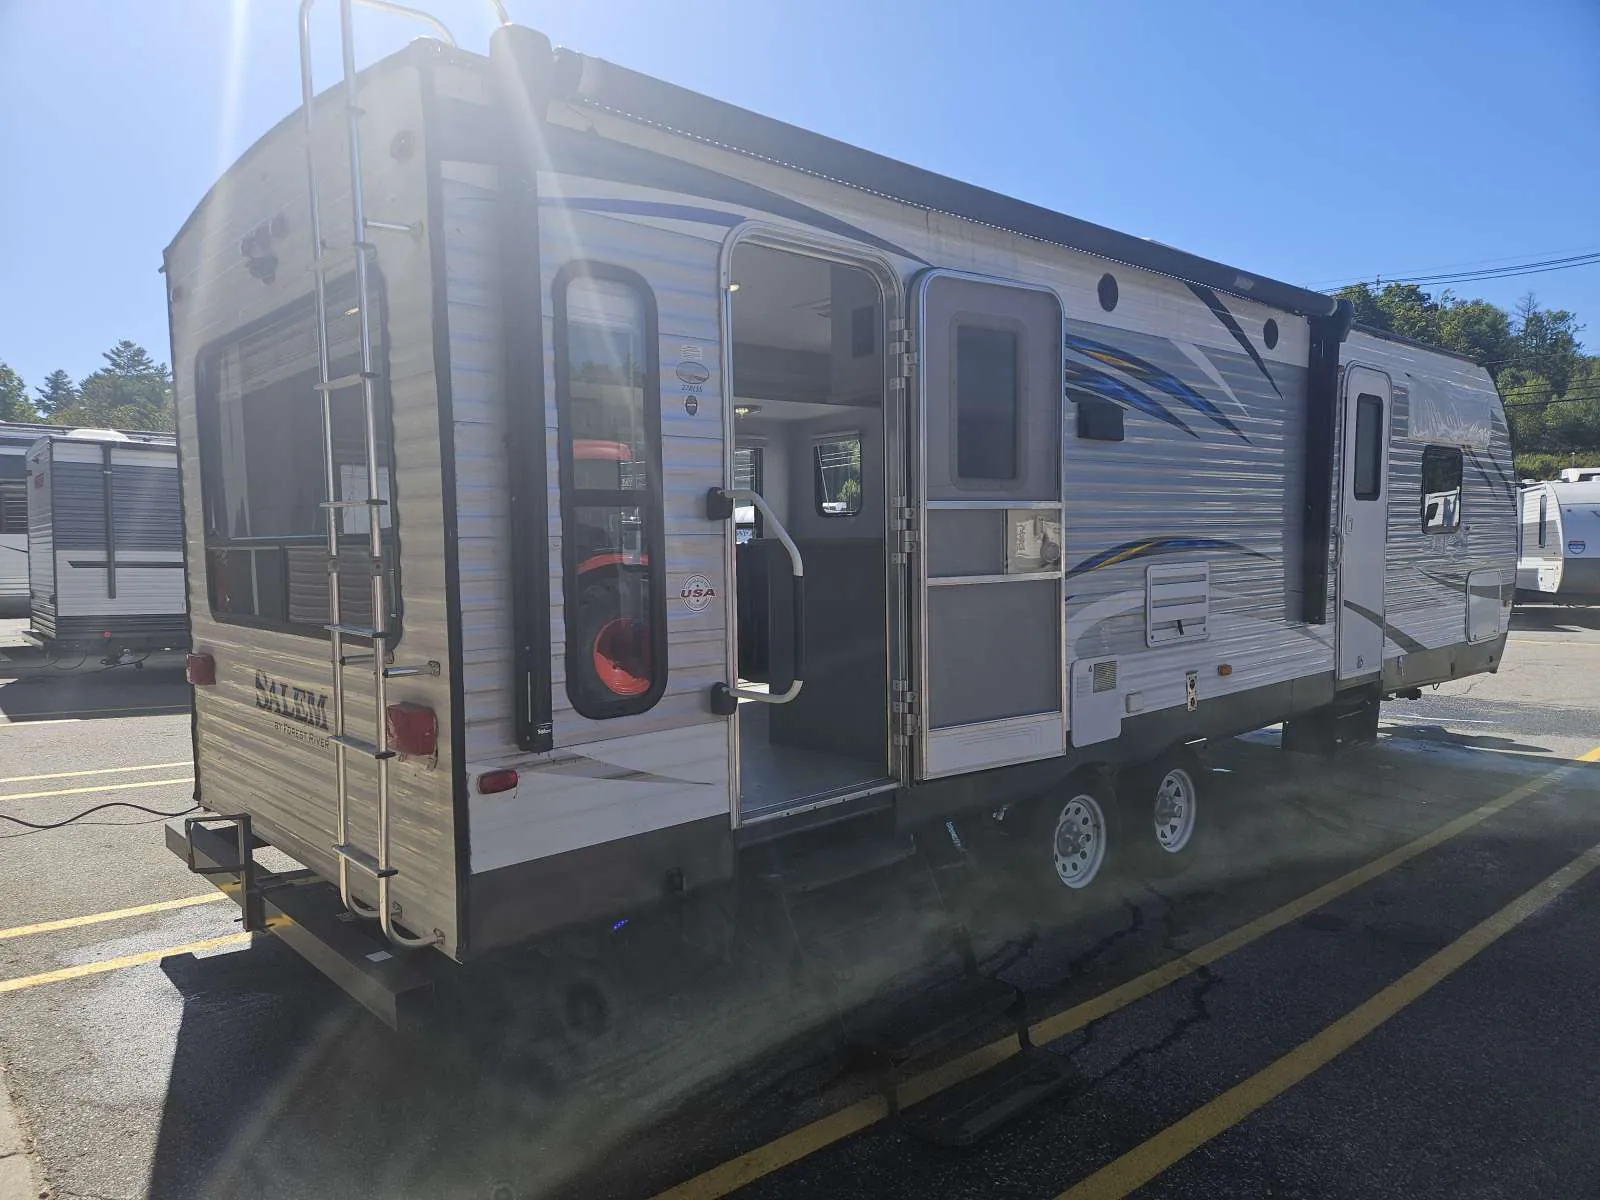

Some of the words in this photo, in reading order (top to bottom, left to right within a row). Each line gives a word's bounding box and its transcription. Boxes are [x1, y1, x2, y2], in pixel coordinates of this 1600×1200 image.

[680, 588, 716, 598] USA
[255, 669, 329, 731] SALEM
[282, 723, 307, 740] FOREST
[308, 732, 329, 749] RIVER
